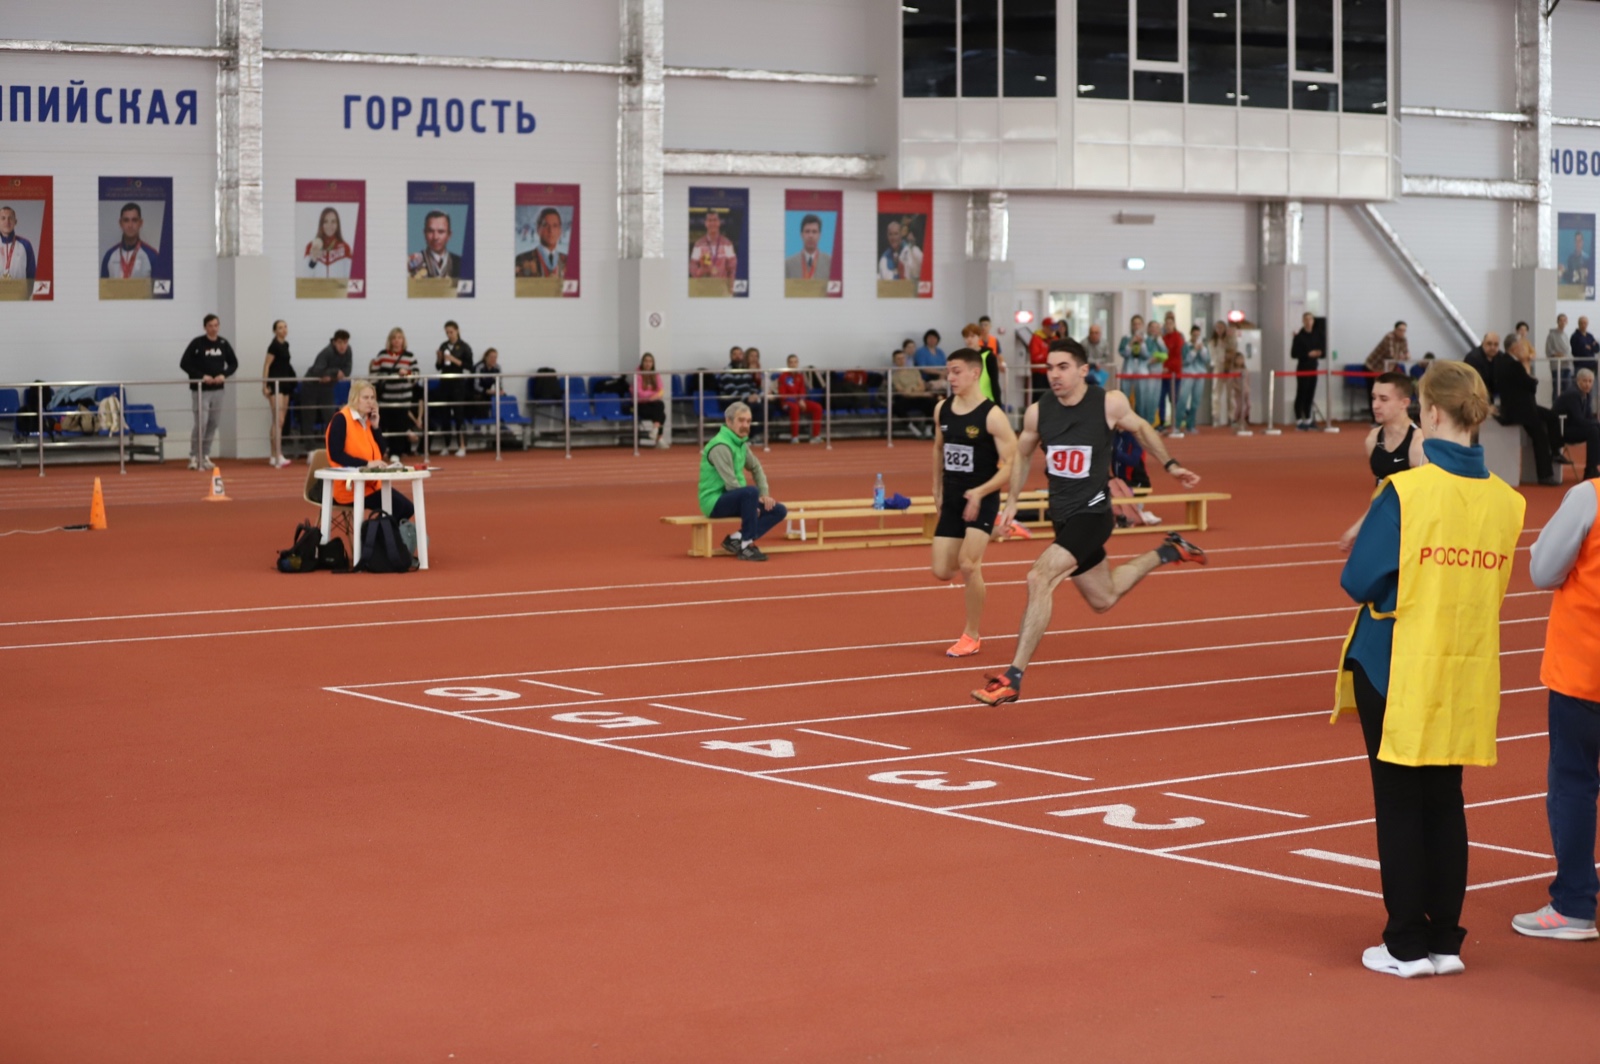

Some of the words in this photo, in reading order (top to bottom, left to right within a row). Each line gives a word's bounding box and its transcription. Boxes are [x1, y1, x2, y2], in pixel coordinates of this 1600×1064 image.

[0, 80, 197, 126] ПИЙСКАЯ
[344, 94, 536, 137] ГОРДОСТЬ
[946, 452, 970, 467] 282
[1052, 450, 1085, 474] 90
[214, 477, 225, 494] 5
[1420, 547, 1508, 570] РОССПОТ
[424, 686, 521, 702] 6
[551, 711, 661, 728] 5
[699, 739, 796, 758] 4
[868, 770, 997, 792] 3
[1047, 804, 1206, 830] 2
